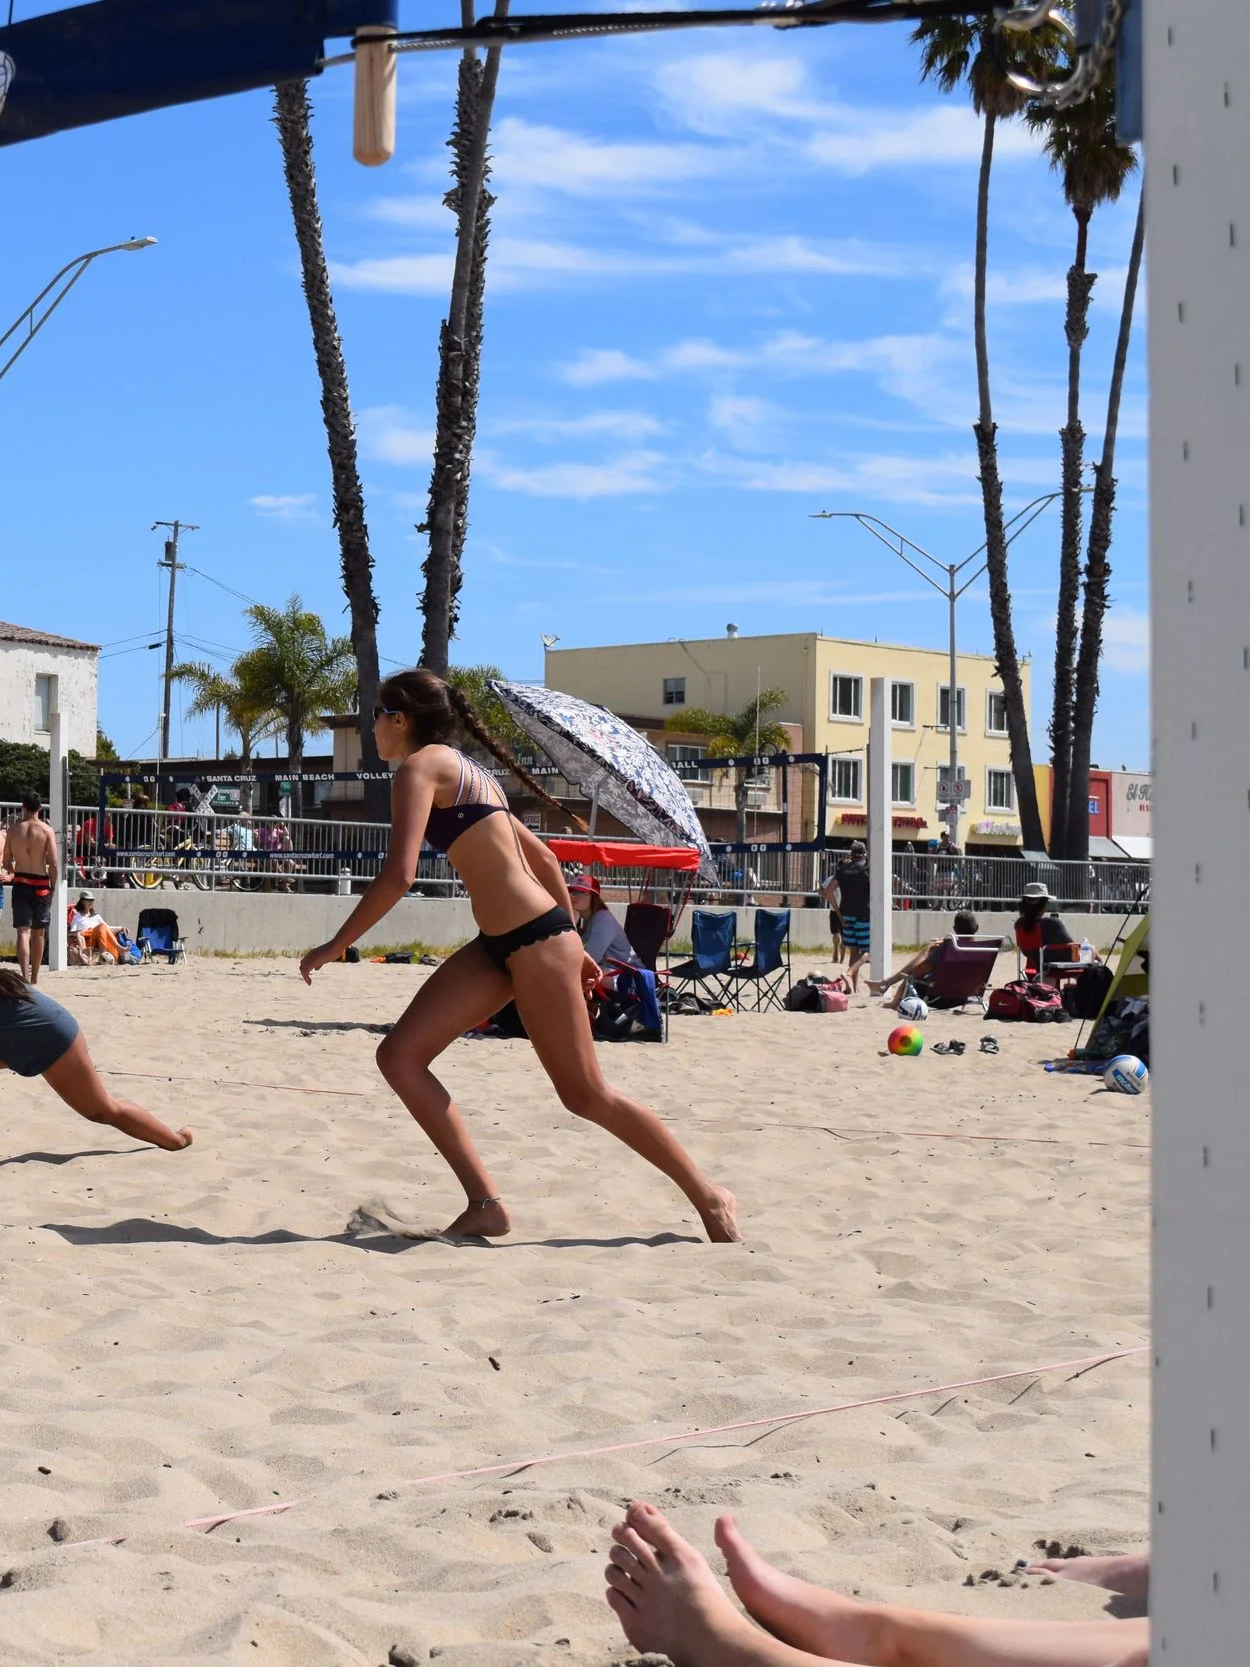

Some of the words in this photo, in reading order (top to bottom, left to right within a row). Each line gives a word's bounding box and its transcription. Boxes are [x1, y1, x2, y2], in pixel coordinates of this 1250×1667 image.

[531, 767, 559, 775] MAIN
[234, 774, 257, 782] CRUZ
[302, 773, 335, 781] BEACH
[356, 772, 396, 780] VOLLEY
